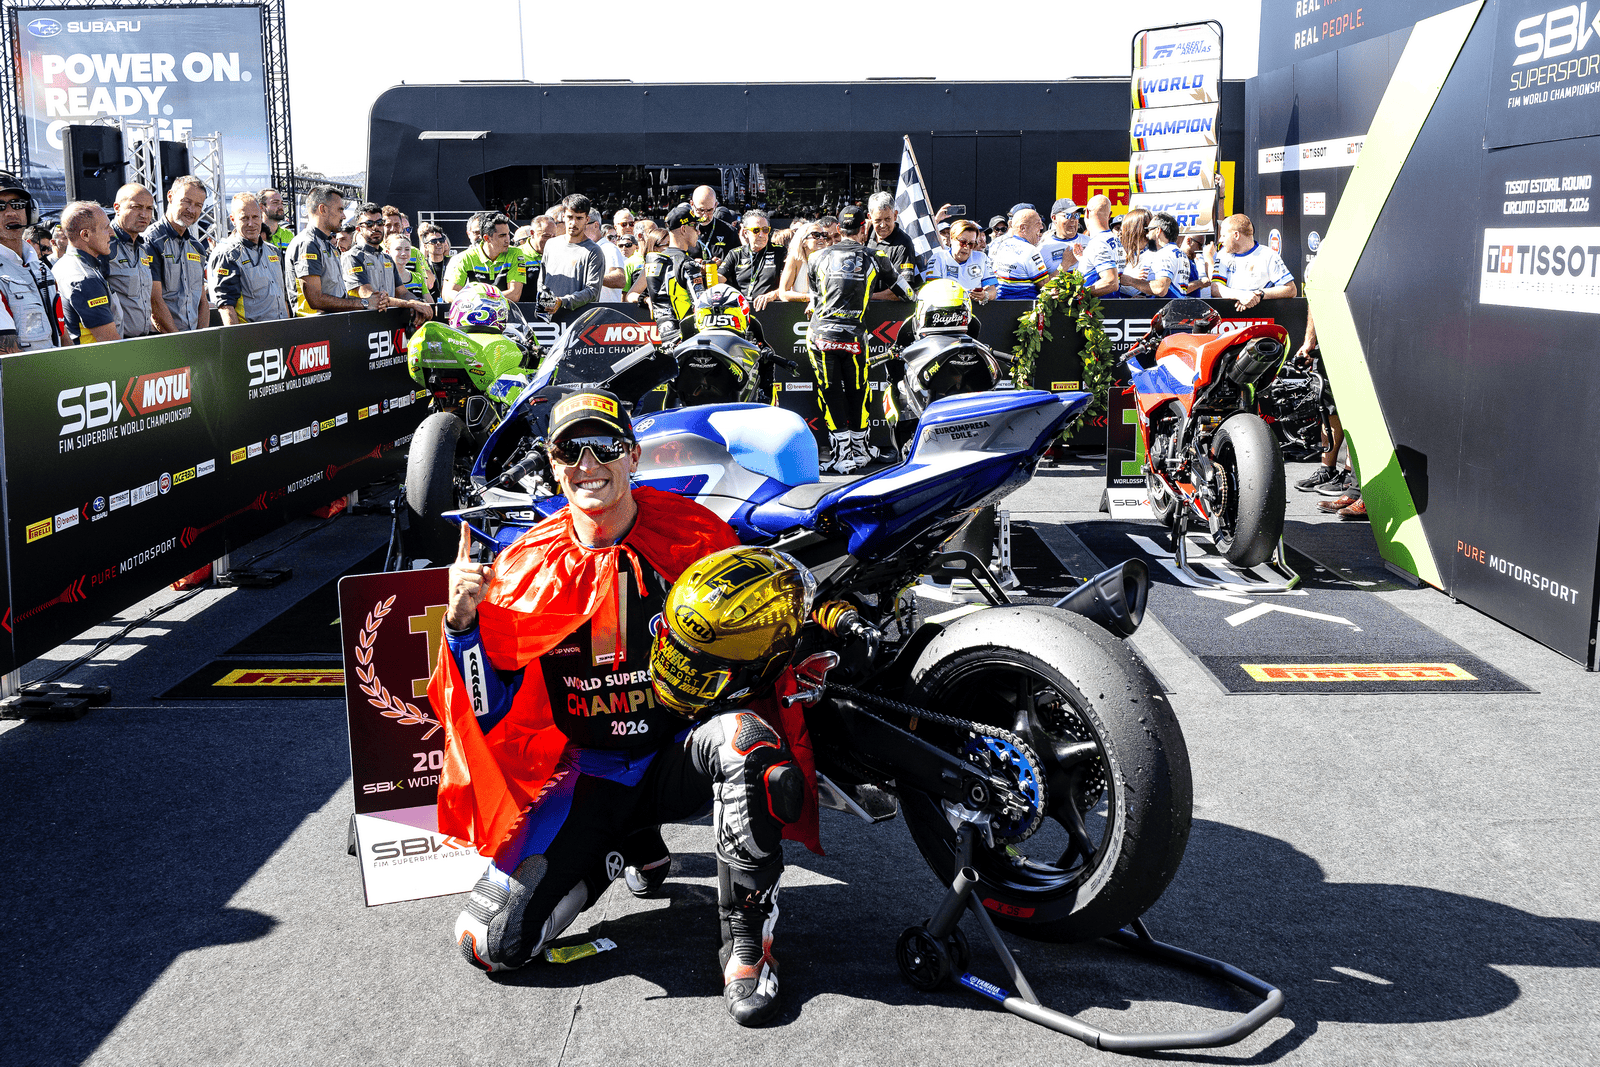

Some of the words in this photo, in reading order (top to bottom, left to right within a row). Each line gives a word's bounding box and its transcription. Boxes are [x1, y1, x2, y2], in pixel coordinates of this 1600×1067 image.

[67, 20, 141, 33] SUBARU
[1294, 25, 1319, 50] REAL
[1322, 8, 1365, 40] PEOPLE.
[1176, 39, 1205, 50] ALBERT
[1180, 44, 1212, 56] ARENAS
[41, 52, 178, 84] POWER
[182, 51, 253, 82] ON.
[1509, 54, 1600, 92] SUPERSPOR
[1142, 74, 1204, 94] WORLD
[1507, 96, 1521, 109] FIM
[1522, 90, 1549, 106] WORLD
[1550, 80, 1600, 101] CHAMPIONSH
[44, 85, 174, 117] READY.
[1132, 117, 1213, 138] CHAMPION
[1143, 160, 1202, 180] 2026
[1504, 179, 1530, 194] TISSOT
[1529, 177, 1561, 193] ESTORIL
[1561, 174, 1592, 191] ROUND
[1503, 200, 1536, 215] CIRCUITO
[1536, 198, 1568, 213] ESTORIL
[1568, 197, 1590, 212] 2026
[1516, 244, 1600, 278] TISSOT
[700, 314, 742, 330] JUST1
[367, 329, 400, 361] SBK
[604, 326, 662, 342] MOTU
[575, 346, 605, 356] WORLD
[247, 345, 297, 387] SBK
[299, 344, 330, 371] MOTUL
[248, 388, 259, 400] FIM
[259, 381, 285, 398] SUPERBIKE
[285, 377, 302, 391] WORLD
[302, 370, 332, 387] CHAMPIONSHIP
[57, 376, 136, 436] SBK
[142, 371, 189, 409] MOTUL
[58, 438, 75, 454] FIM
[76, 425, 119, 449] SUPERBIKE
[120, 419, 145, 437] WORLD
[146, 406, 192, 430] CHAMPIONSHIP
[934, 420, 991, 435] EUROIMPRESA
[950, 430, 973, 441] EDILE
[287, 470, 324, 495] MOTORSPORT
[28, 520, 51, 540] PIRELLI
[173, 467, 196, 485] ACERBIS
[505, 510, 535, 521] R9
[91, 565, 117, 588] PURE
[119, 536, 177, 575] MOTORSPORT
[1457, 539, 1486, 565] PURE
[1489, 554, 1579, 605] MOTORSPORT
[676, 610, 713, 640] Arai
[563, 646, 581, 654] WORL
[660, 636, 691, 667] ALBERT
[660, 646, 698, 677] ARENAS
[1261, 666, 1458, 679] PIRELLI
[563, 676, 602, 692] WORLD
[604, 669, 652, 687] SUPERS
[678, 681, 700, 695] 2026
[567, 687, 659, 718] CHAMPI
[610, 719, 649, 736] 2026
[412, 749, 444, 773] 20
[362, 779, 404, 795] SBK
[407, 774, 441, 788] WOR
[373, 860, 389, 868] FIM
[392, 853, 439, 866] SUPERBIKE
[441, 848, 470, 859] WORLD
[976, 977, 1001, 994] YAMAHA
